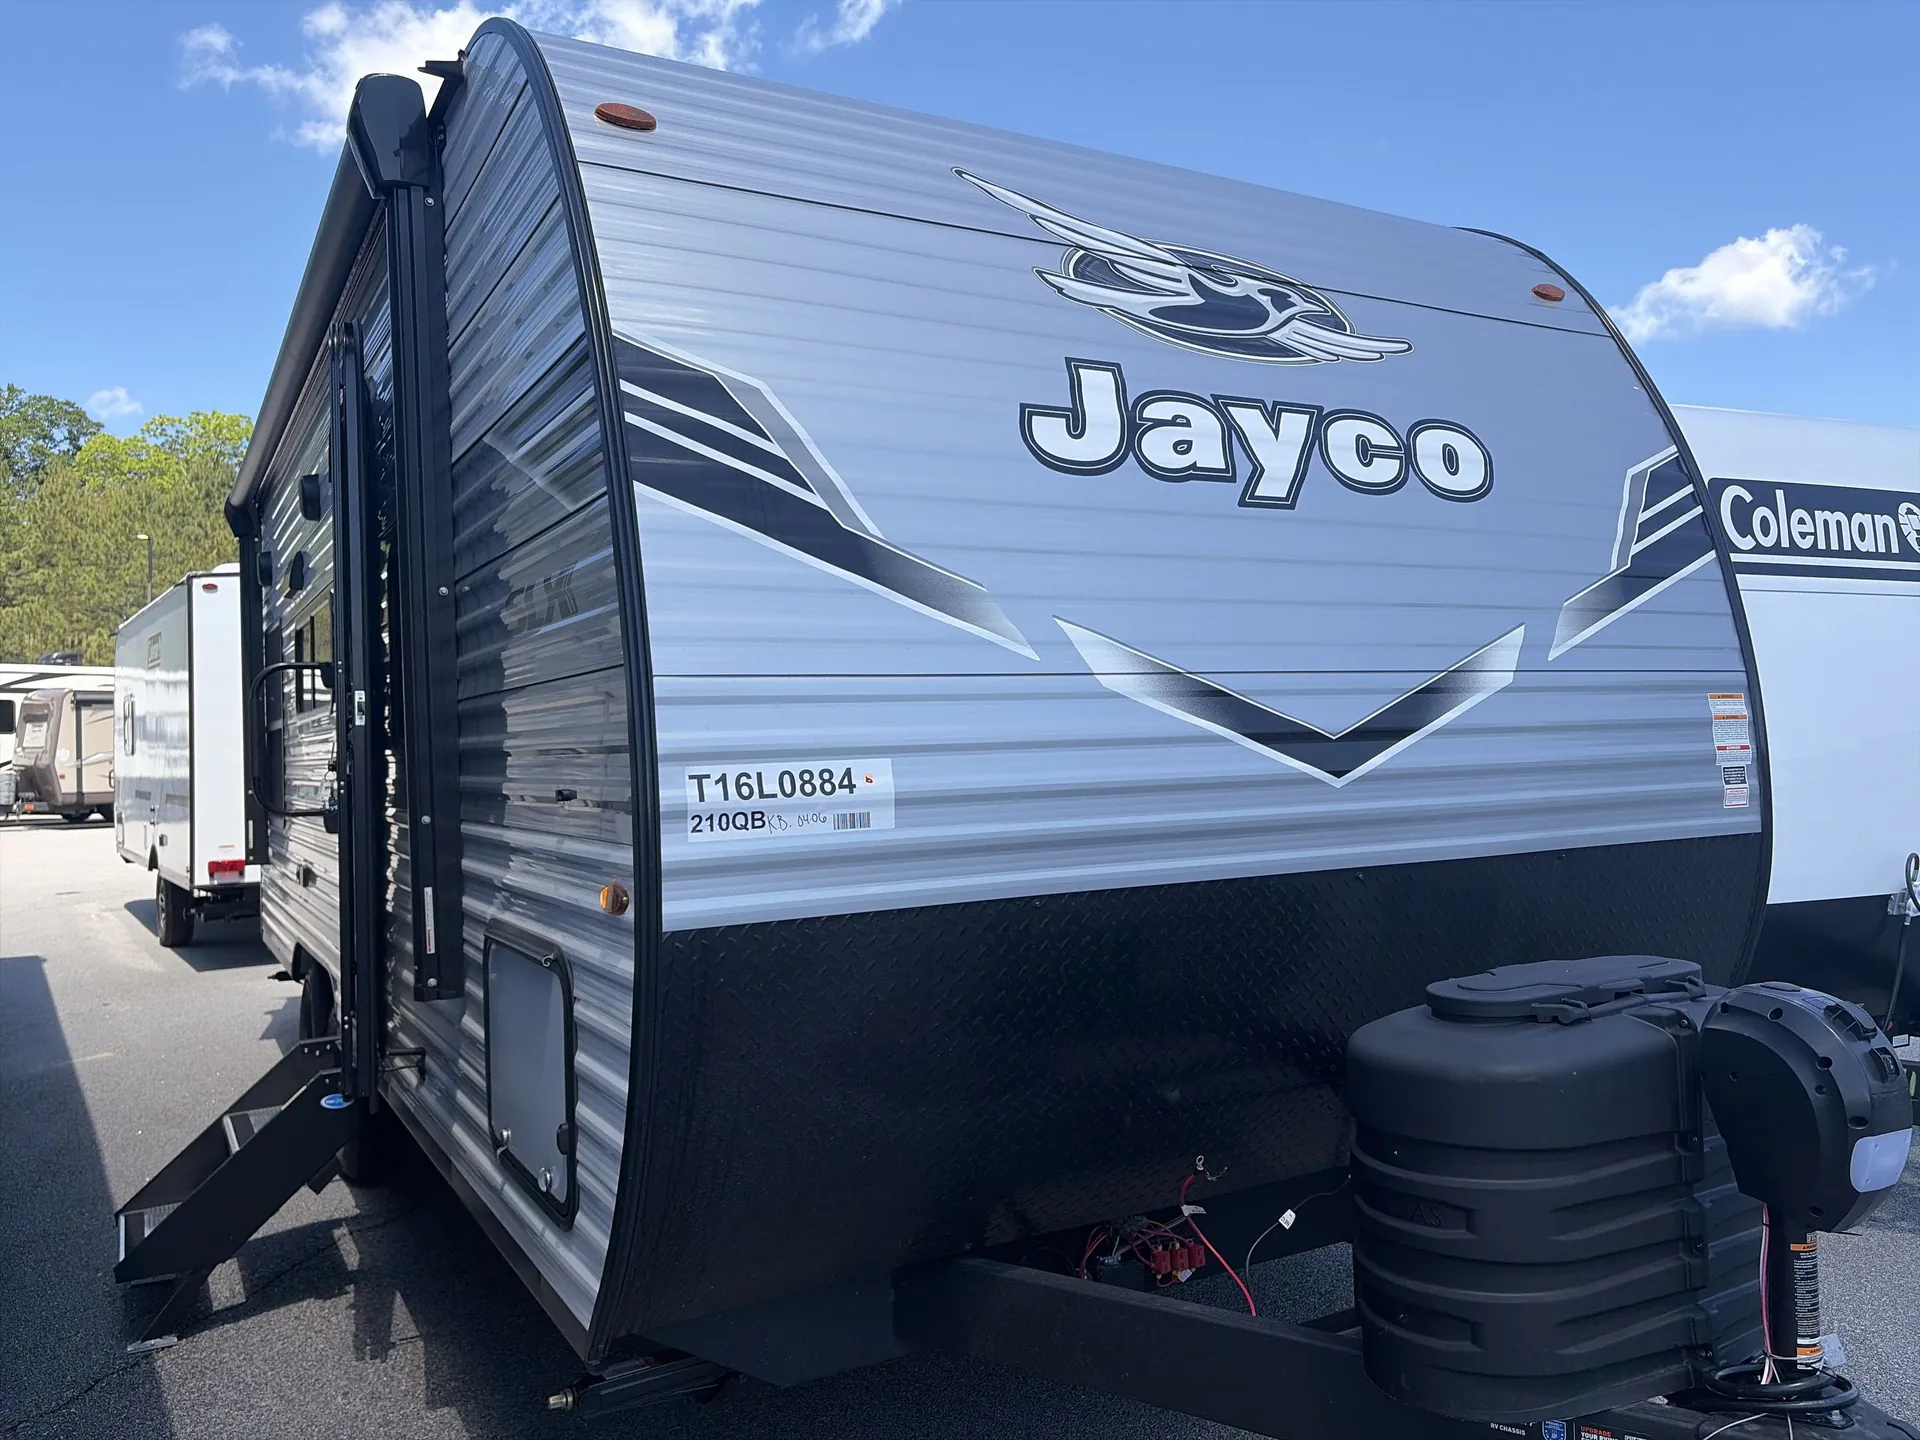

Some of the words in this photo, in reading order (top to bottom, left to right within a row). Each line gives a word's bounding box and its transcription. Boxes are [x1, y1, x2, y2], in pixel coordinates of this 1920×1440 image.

[1020, 357, 1494, 510] Jayco
[1720, 484, 1899, 554] Coleman
[688, 767, 857, 803] T16L0884
[690, 810, 766, 834] 210QB
[1490, 1422, 1499, 1430] RV
[1499, 1424, 1526, 1436] CHASSIS
[1580, 1425, 1612, 1438] UPGRADE
